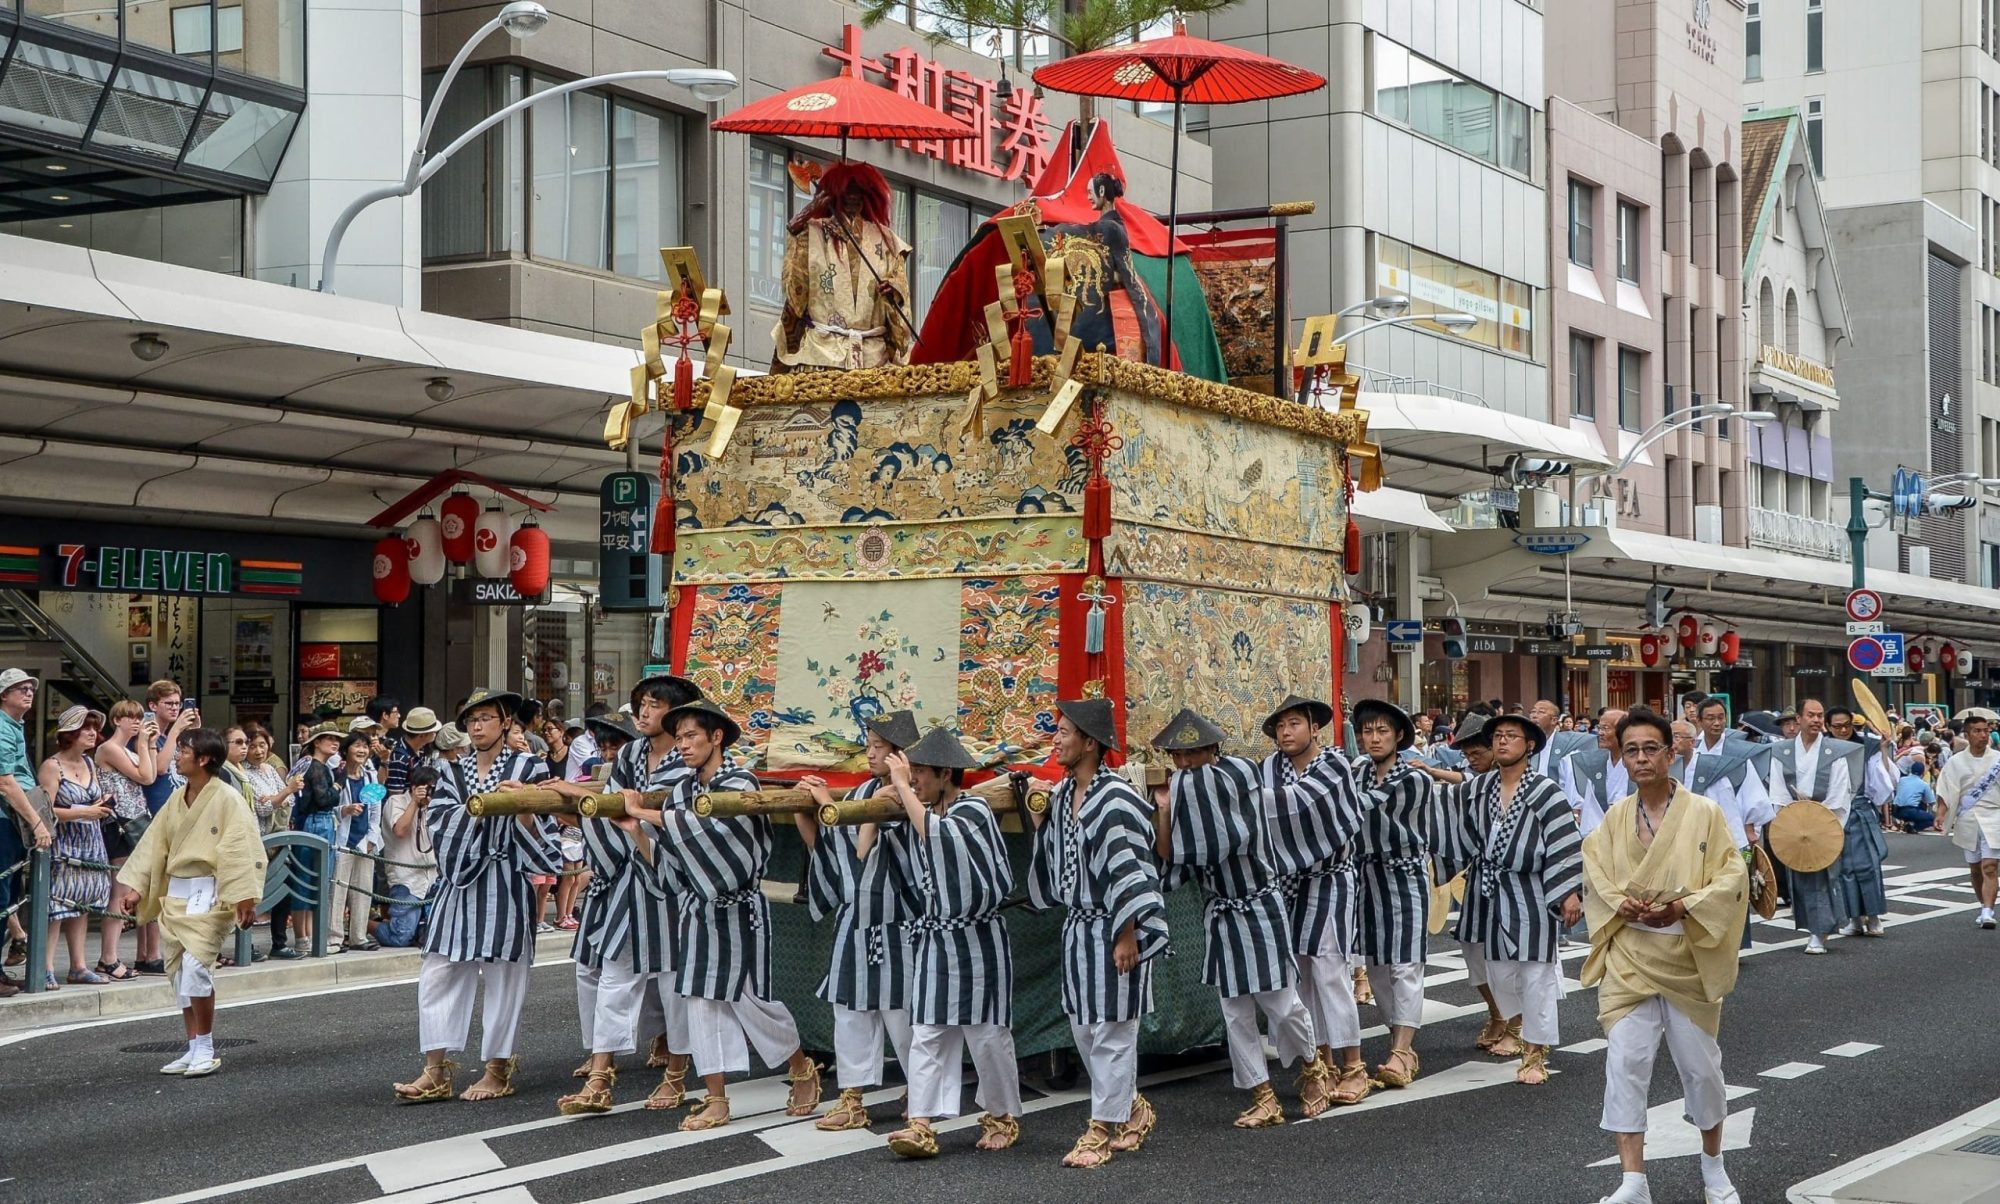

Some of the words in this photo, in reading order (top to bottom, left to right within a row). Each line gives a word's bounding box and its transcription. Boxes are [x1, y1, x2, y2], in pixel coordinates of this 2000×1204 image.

[602, 511, 630, 527] フヤ町
[602, 534, 630, 551] 平安
[475, 583, 523, 600] SAKIZ
[1879, 640, 1899, 660] 停
